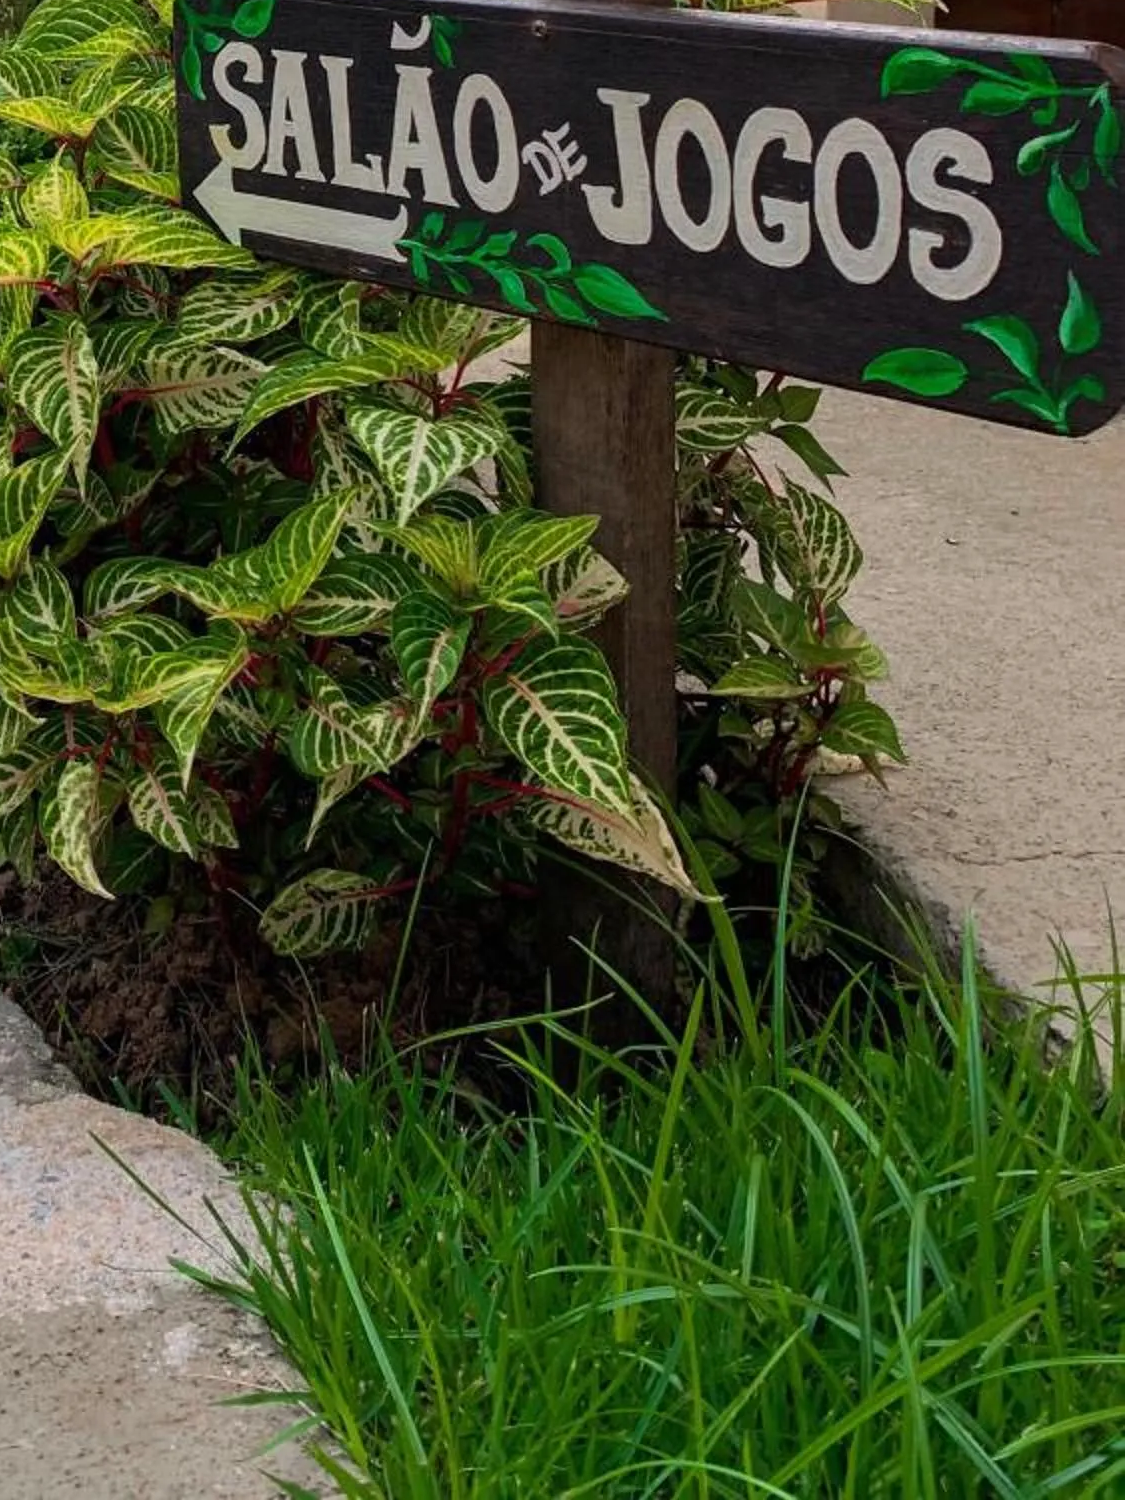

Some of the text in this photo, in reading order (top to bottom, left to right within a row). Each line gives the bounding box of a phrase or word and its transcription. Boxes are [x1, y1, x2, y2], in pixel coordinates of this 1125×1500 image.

[209, 14, 1003, 302] SALÃO DE JOGOS
